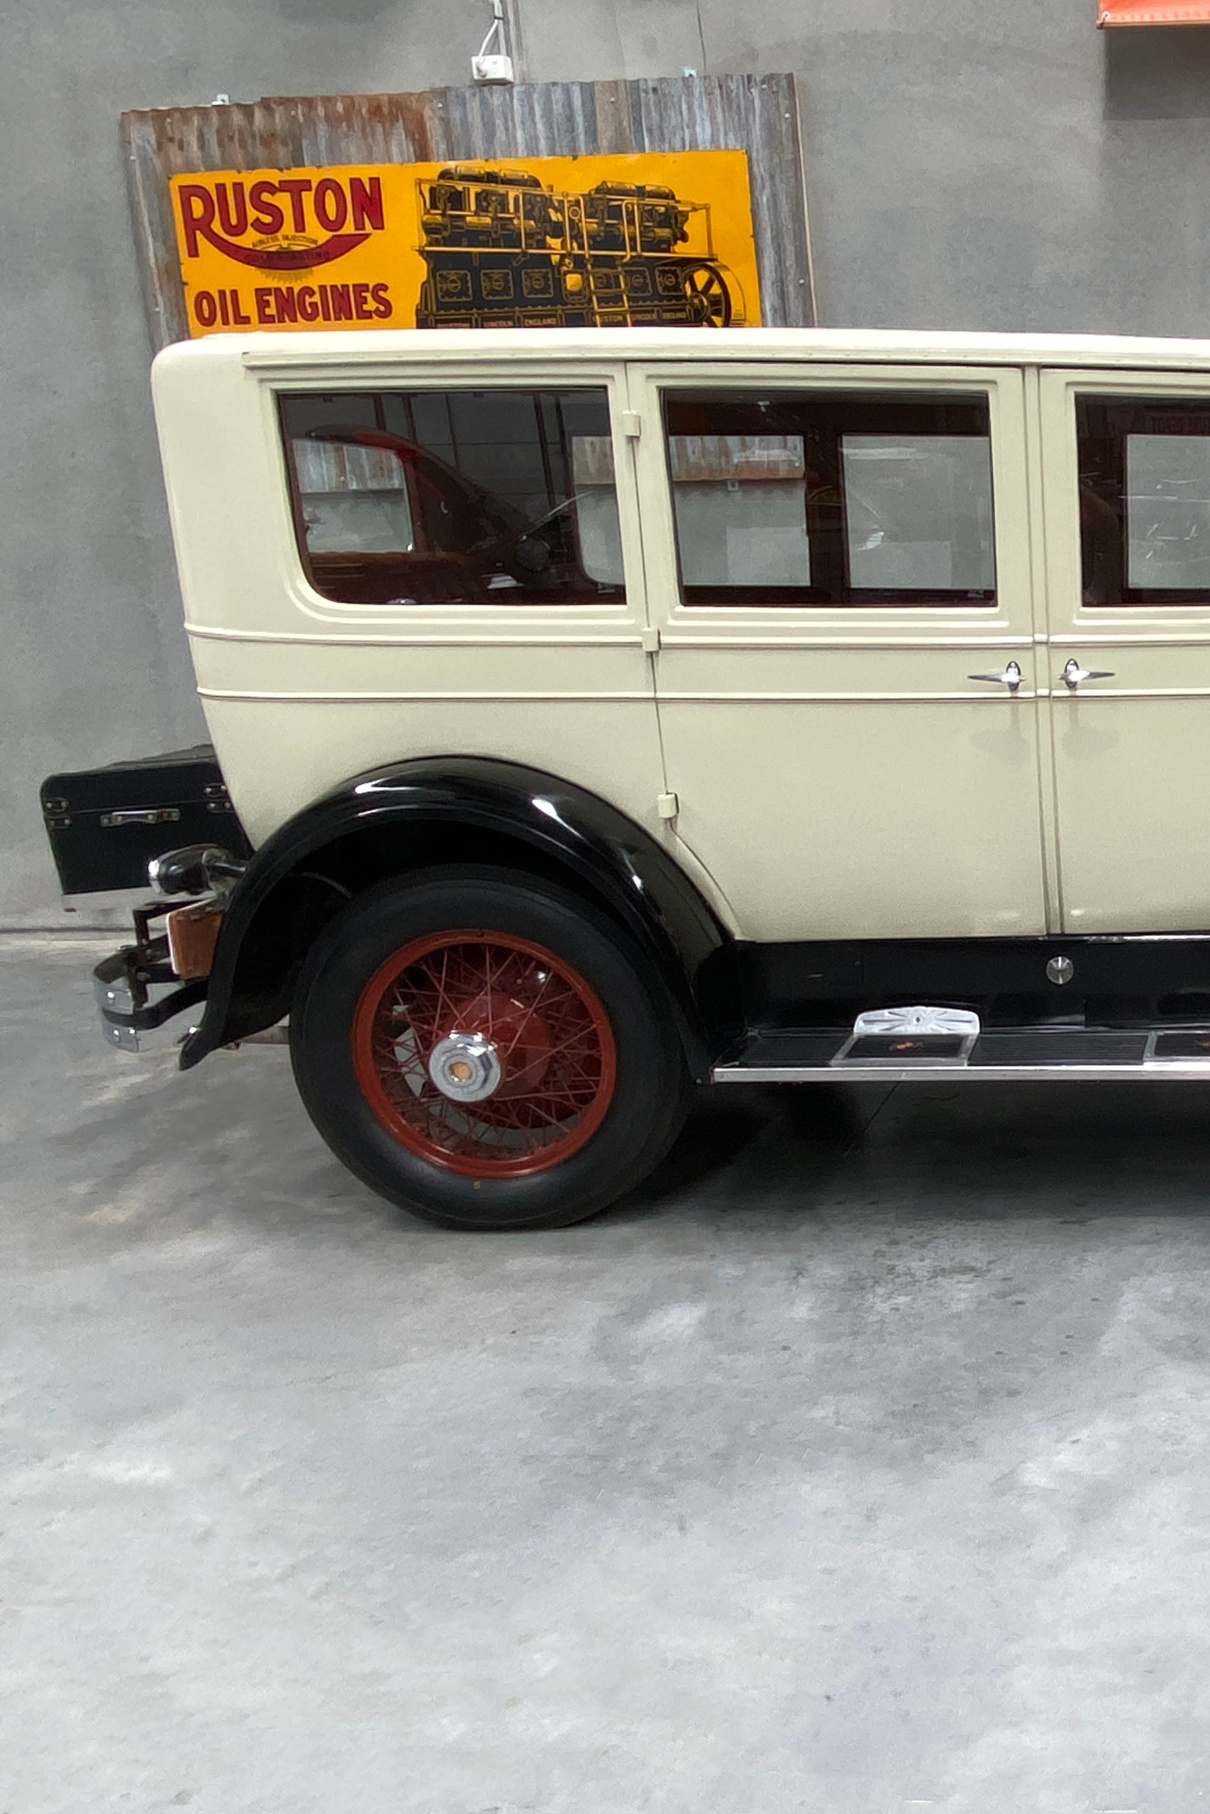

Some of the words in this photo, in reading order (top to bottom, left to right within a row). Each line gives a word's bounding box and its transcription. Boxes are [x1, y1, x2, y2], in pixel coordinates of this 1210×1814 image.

[178, 176, 385, 259] RUSTON
[194, 288, 252, 327] OIL
[254, 282, 393, 325] ENGINES
